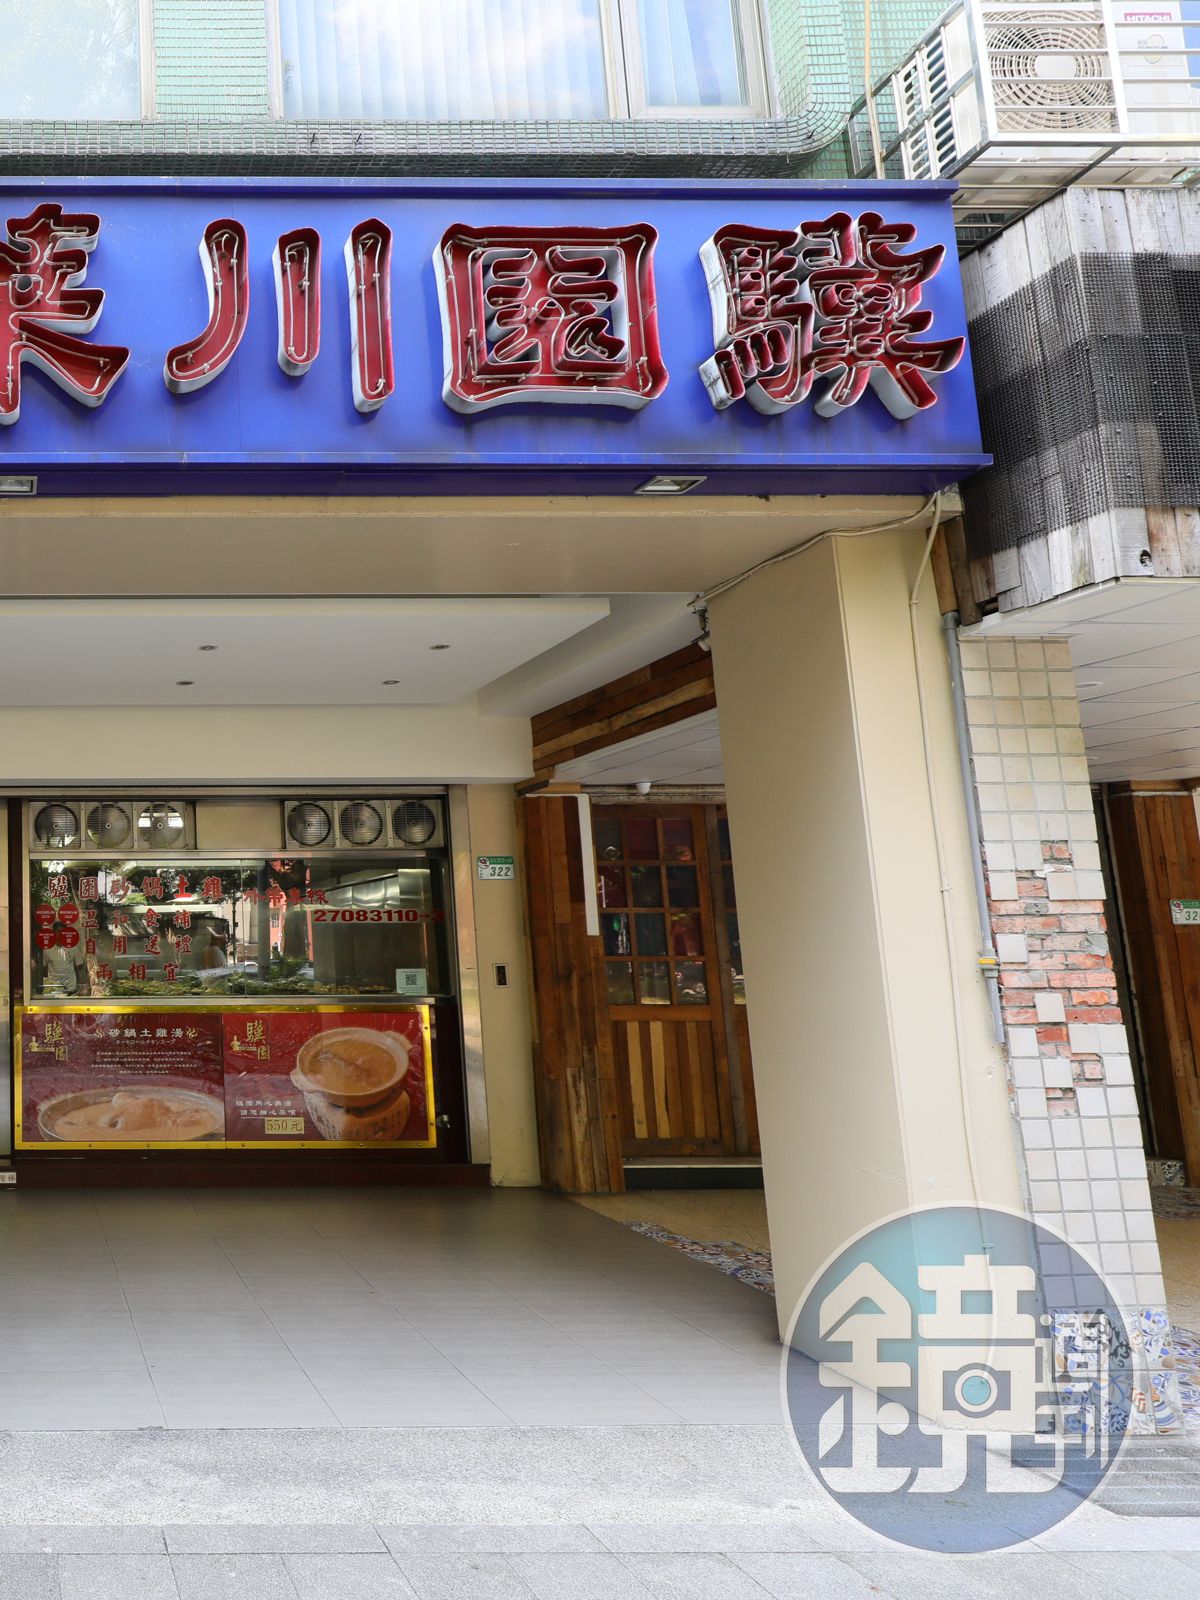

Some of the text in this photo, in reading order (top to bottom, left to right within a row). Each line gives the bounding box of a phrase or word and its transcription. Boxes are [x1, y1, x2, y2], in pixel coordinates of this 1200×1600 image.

[490, 866, 511, 877] 322
[1185, 911, 1200, 921] 32
[107, 1028, 184, 1038] 砂鍋土雞湯
